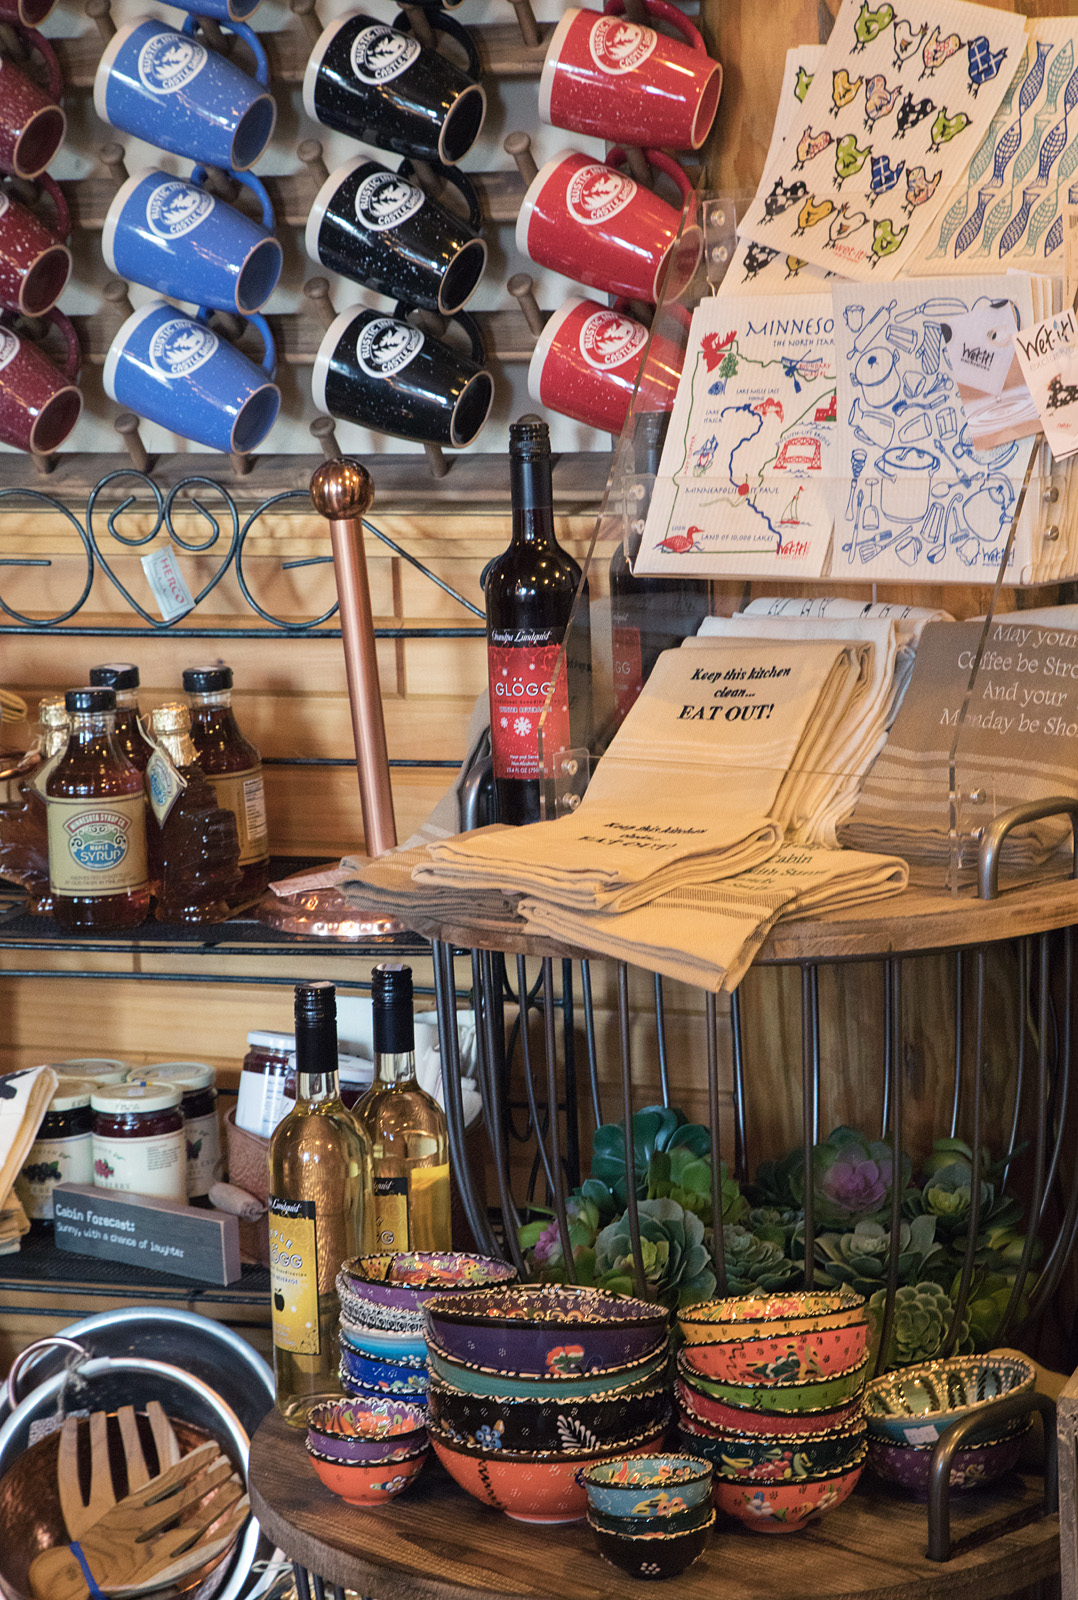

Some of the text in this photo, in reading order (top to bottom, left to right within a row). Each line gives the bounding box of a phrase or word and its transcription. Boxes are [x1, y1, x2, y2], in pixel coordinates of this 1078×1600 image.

[356, 31, 374, 64] RUSTIC
[595, 21, 609, 56] RUSTIC
[144, 40, 162, 73] RUSTIC
[375, 55, 408, 79] CASTLE
[620, 43, 648, 69] CASTLE
[162, 63, 196, 88] CASTLE
[360, 179, 380, 210] RUSTIC
[571, 170, 590, 204] RUSTIC
[151, 187, 170, 219] RUSTIC
[378, 205, 412, 224] CASTLE
[590, 197, 623, 218] CASTLE
[170, 209, 202, 233] CASTLE
[154, 326, 174, 356] RUSTIC
[361, 326, 378, 359] RUSTIC
[585, 318, 602, 349] RUSTIC
[171, 350, 205, 373] CASTLE
[382, 348, 412, 372] CASTLE
[604, 343, 636, 363] CASTLE
[684, 486, 737, 494] MINNEAPOLIS
[160, 558, 184, 604] HERCO
[993, 625, 1032, 648] May
[1016, 652, 1038, 673] be
[496, 676, 556, 696] GLÖGG
[690, 666, 792, 684] Keep this kitchen
[714, 686, 756, 698] clean...
[982, 680, 1068, 708] And your
[677, 704, 775, 722] EAT OUT!
[1018, 713, 1040, 733] be
[70, 813, 99, 830] MINNESOTA
[100, 813, 119, 824] SYRUP
[80, 850, 120, 862] SYRUP
[56, 1204, 136, 1232] Cabin Forecast:
[57, 1222, 80, 1237] Sunny,
[83, 1228, 101, 1239] with
[110, 1234, 136, 1247] chance
[138, 1240, 148, 1249] of
[150, 1242, 184, 1258] laughter
